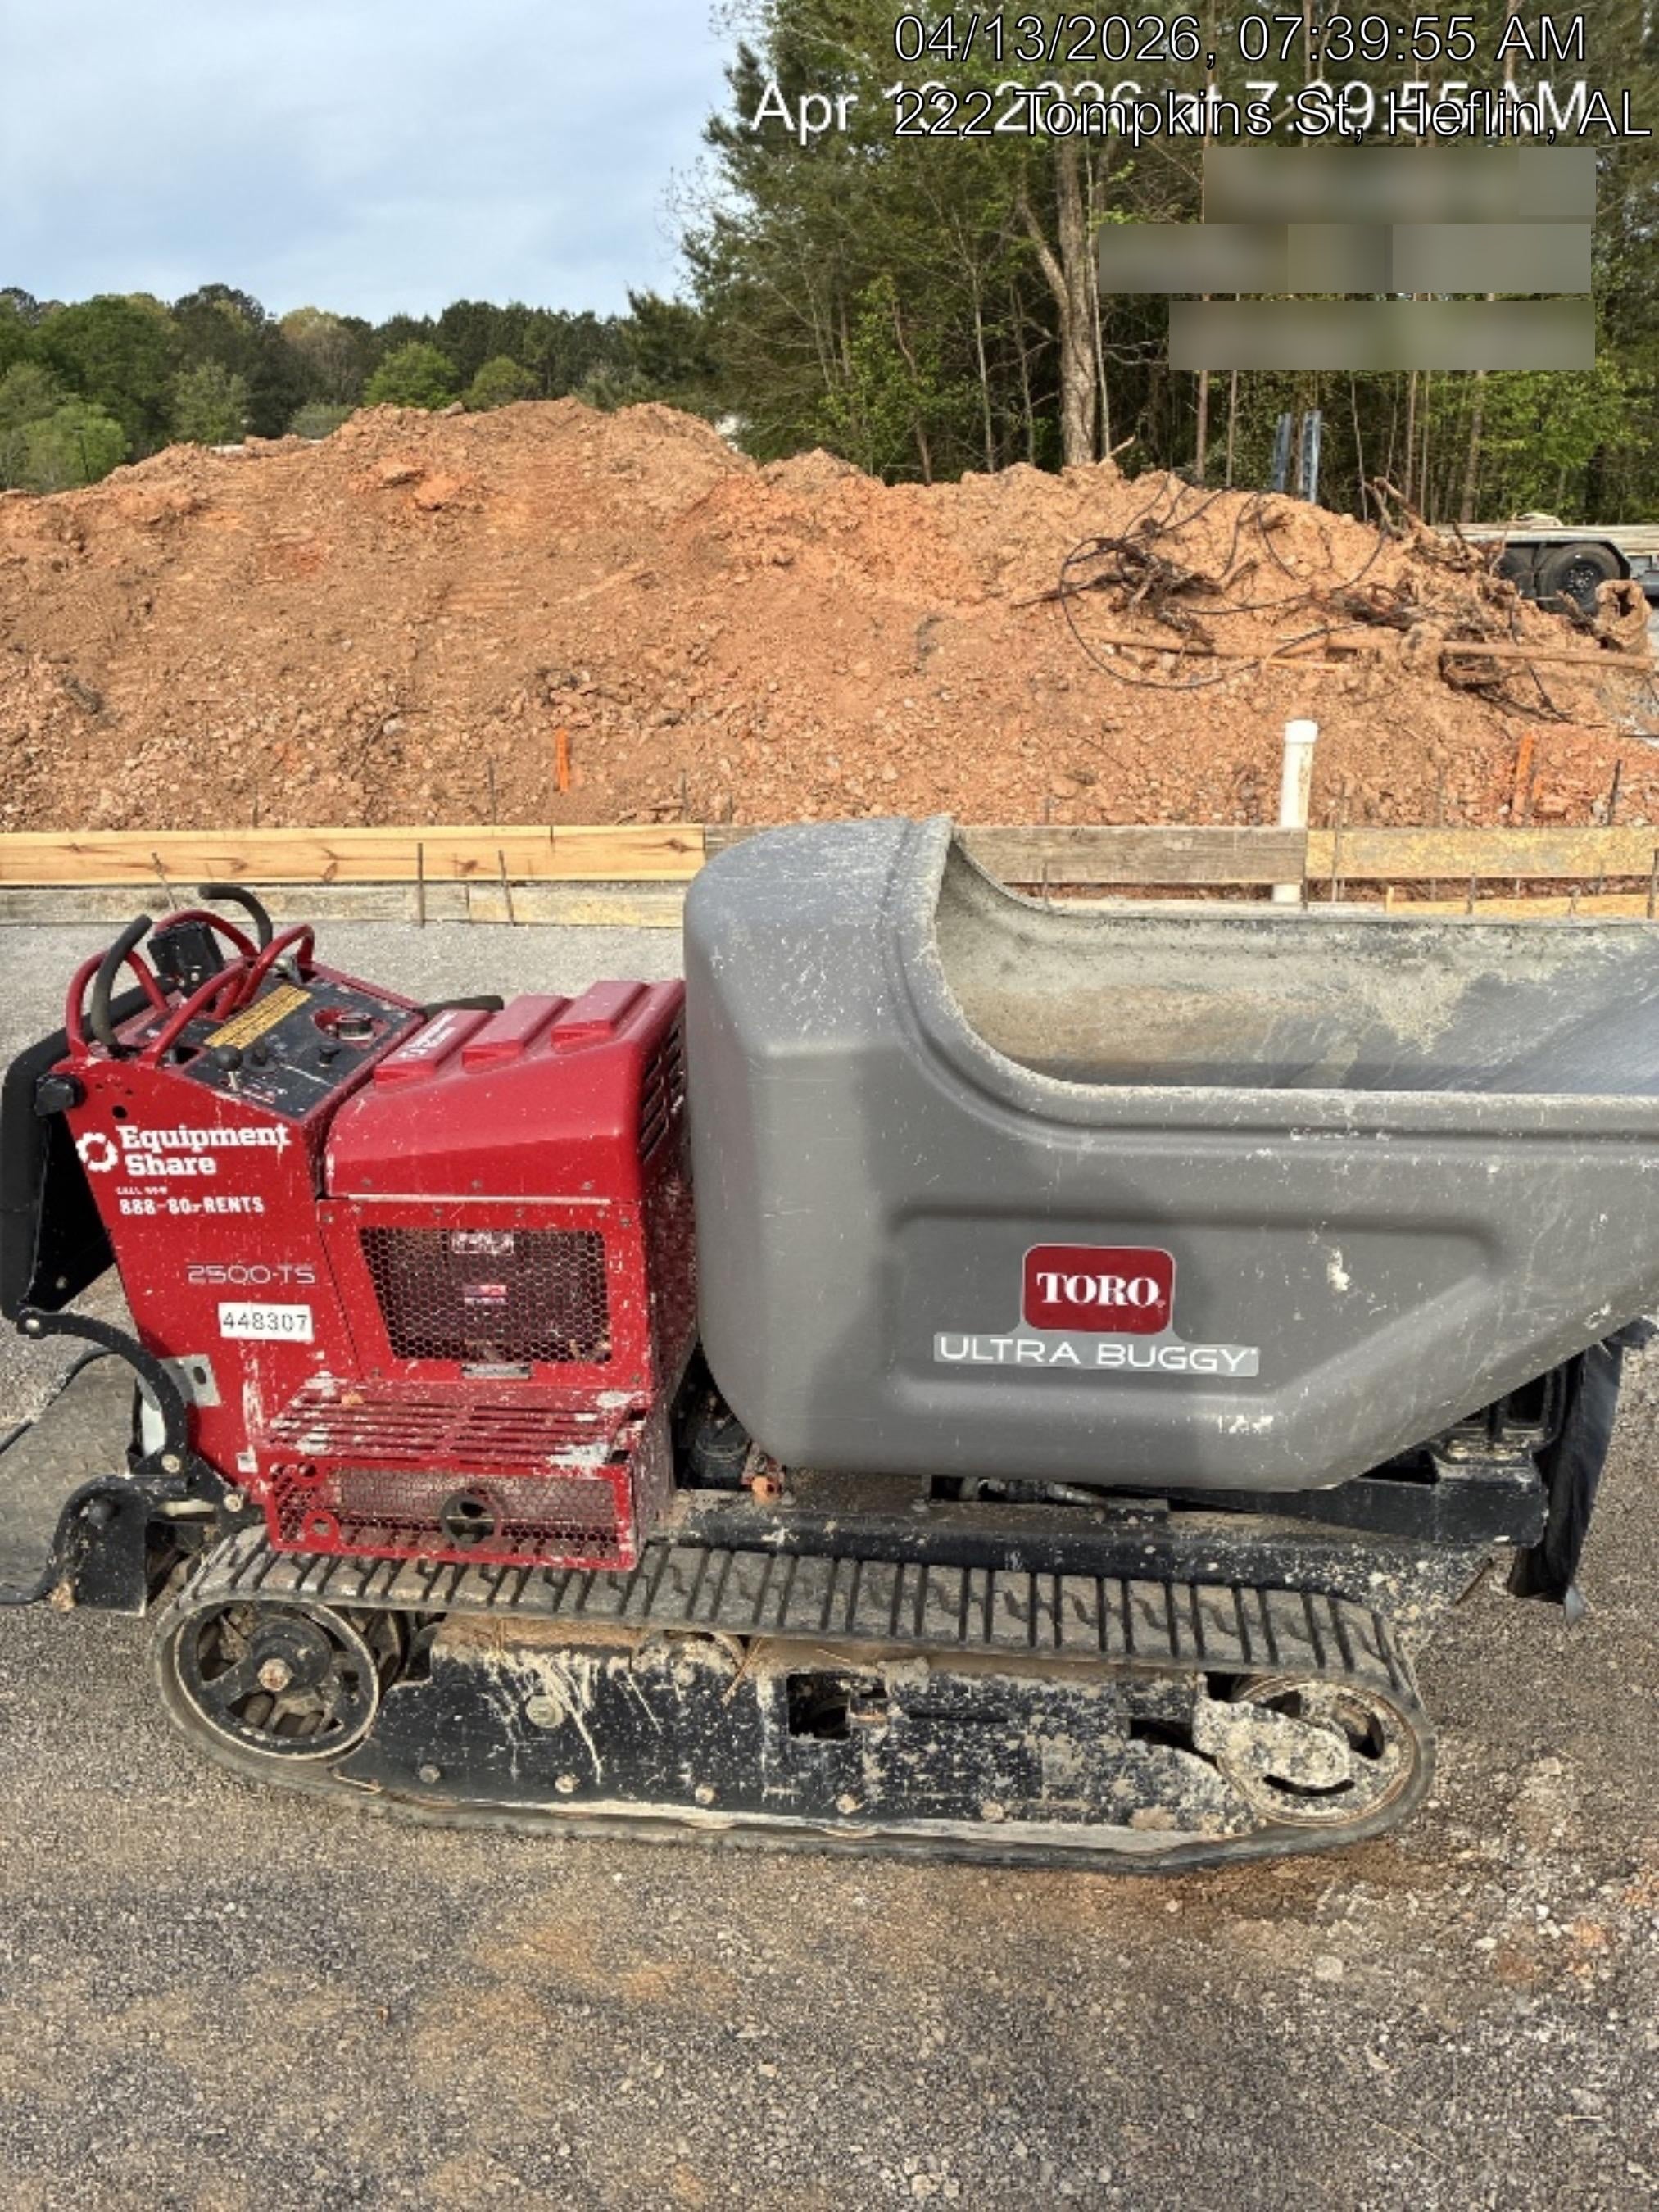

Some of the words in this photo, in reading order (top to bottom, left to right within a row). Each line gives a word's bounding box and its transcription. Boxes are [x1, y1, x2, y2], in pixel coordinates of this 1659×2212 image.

[116, 1123, 291, 1152] Equipment
[125, 1154, 217, 1176] Share
[1036, 1272, 1160, 1308] TORO
[223, 1312, 309, 1332] 448307
[940, 1335, 1081, 1365] ULTRA
[1096, 1344, 1258, 1374] BUGGY
